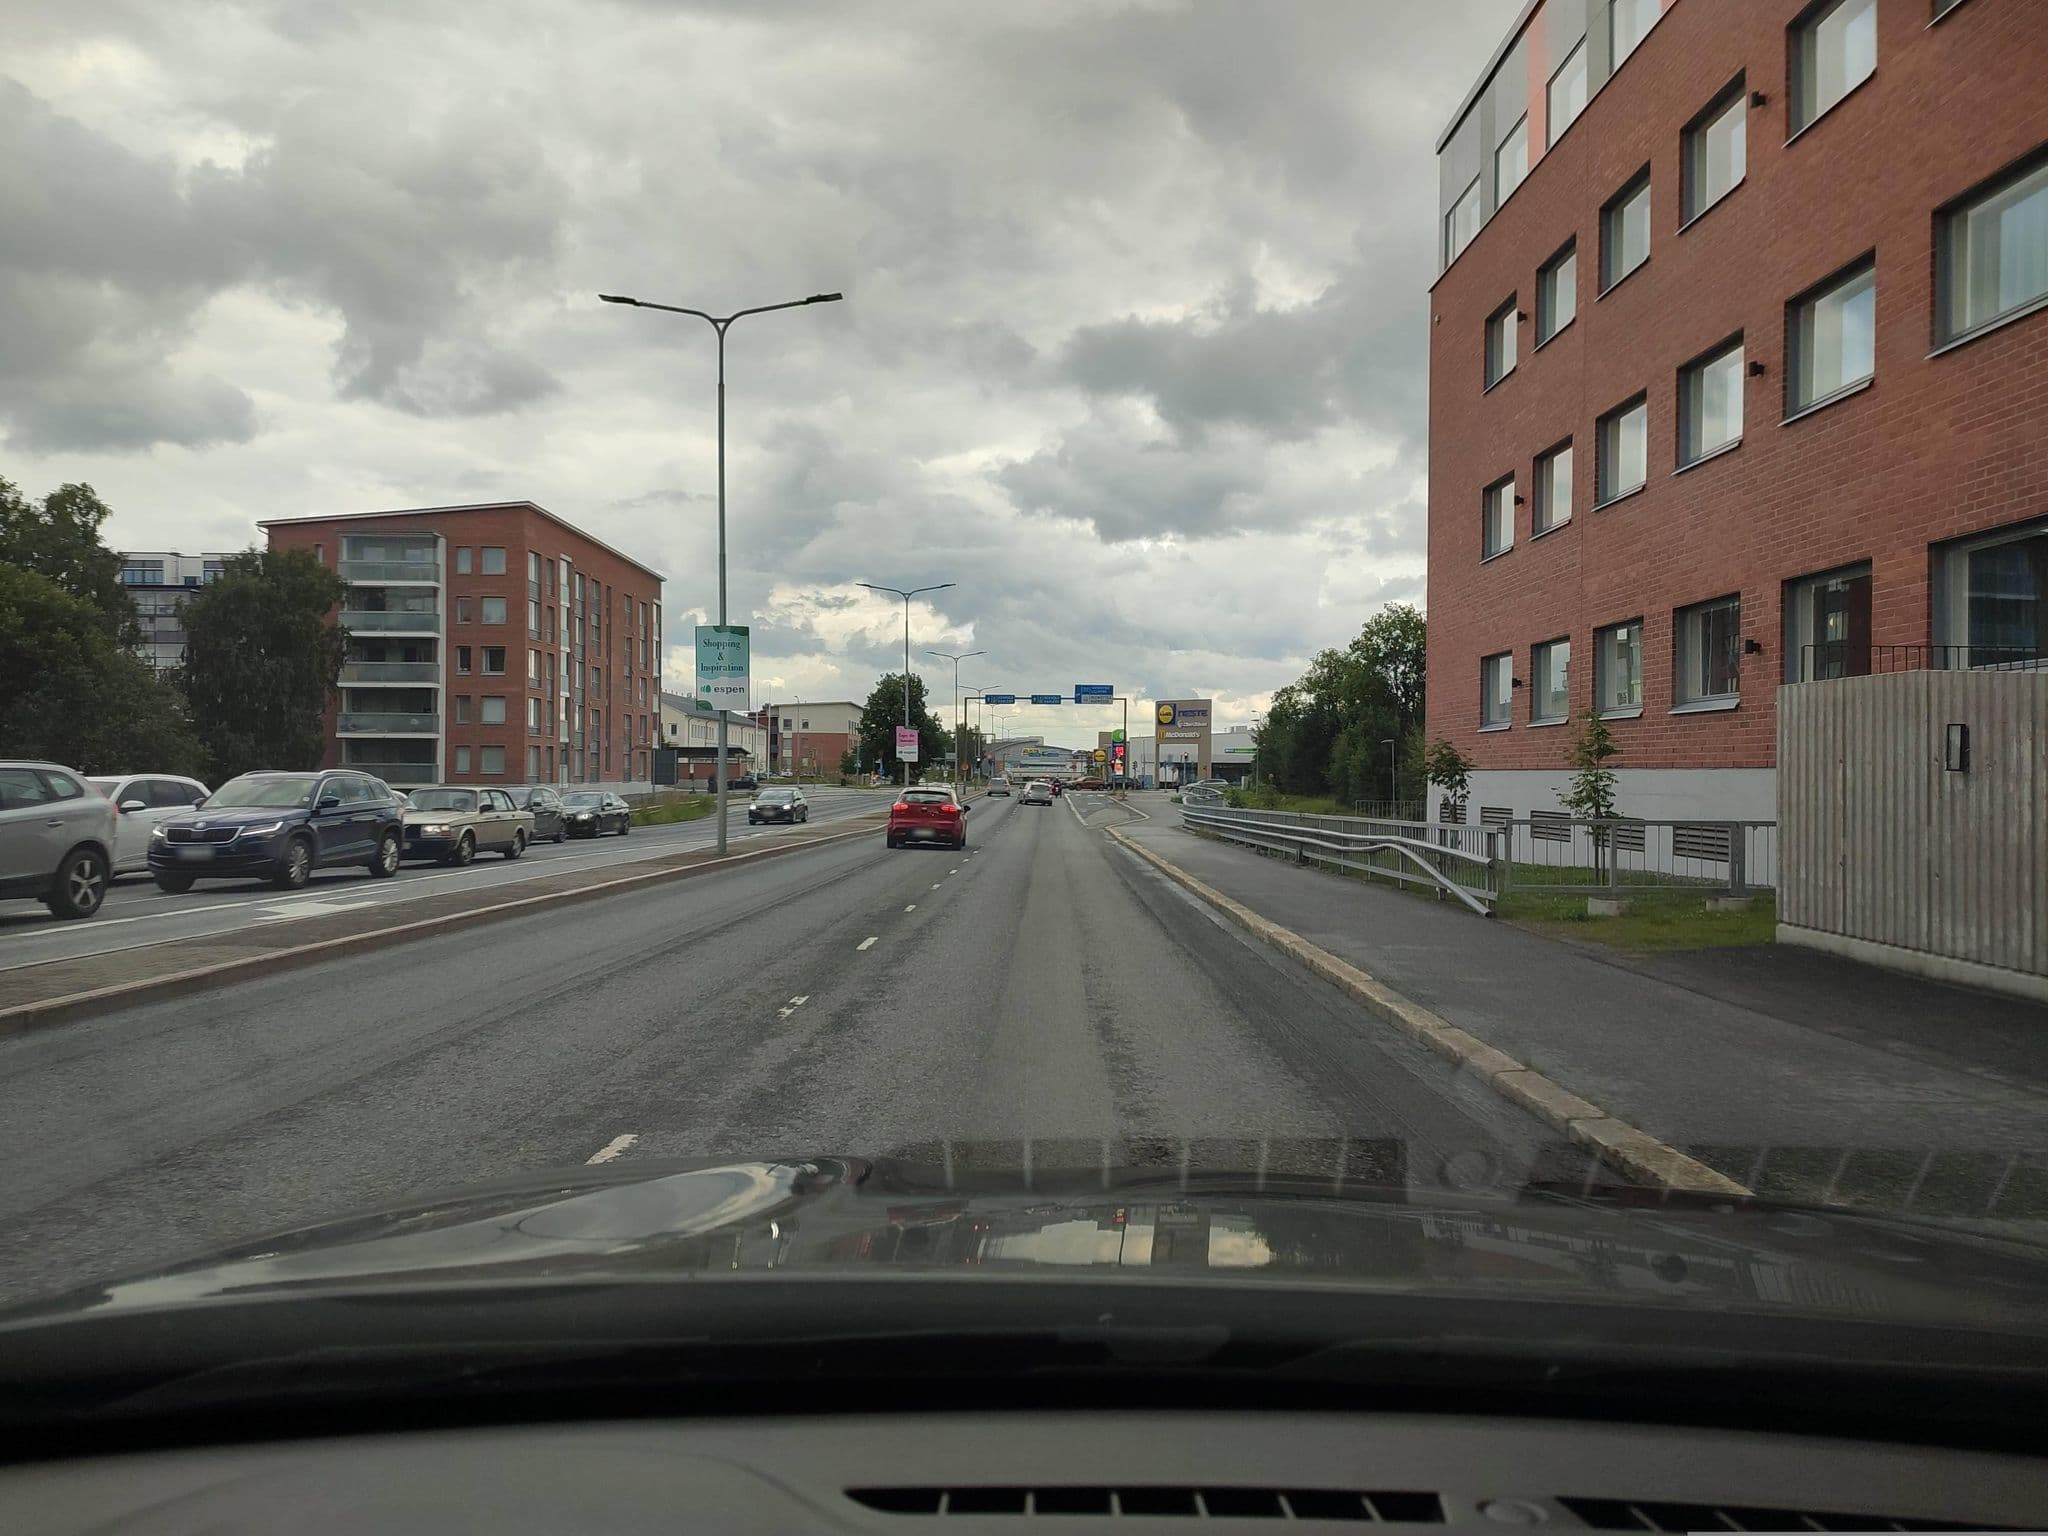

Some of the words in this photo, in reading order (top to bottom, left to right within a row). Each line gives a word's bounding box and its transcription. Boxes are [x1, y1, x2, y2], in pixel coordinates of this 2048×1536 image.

[703, 639, 741, 650] Shopping
[717, 651, 724, 661] &
[701, 662, 744, 673] Inspiration
[714, 686, 744, 695] espen
